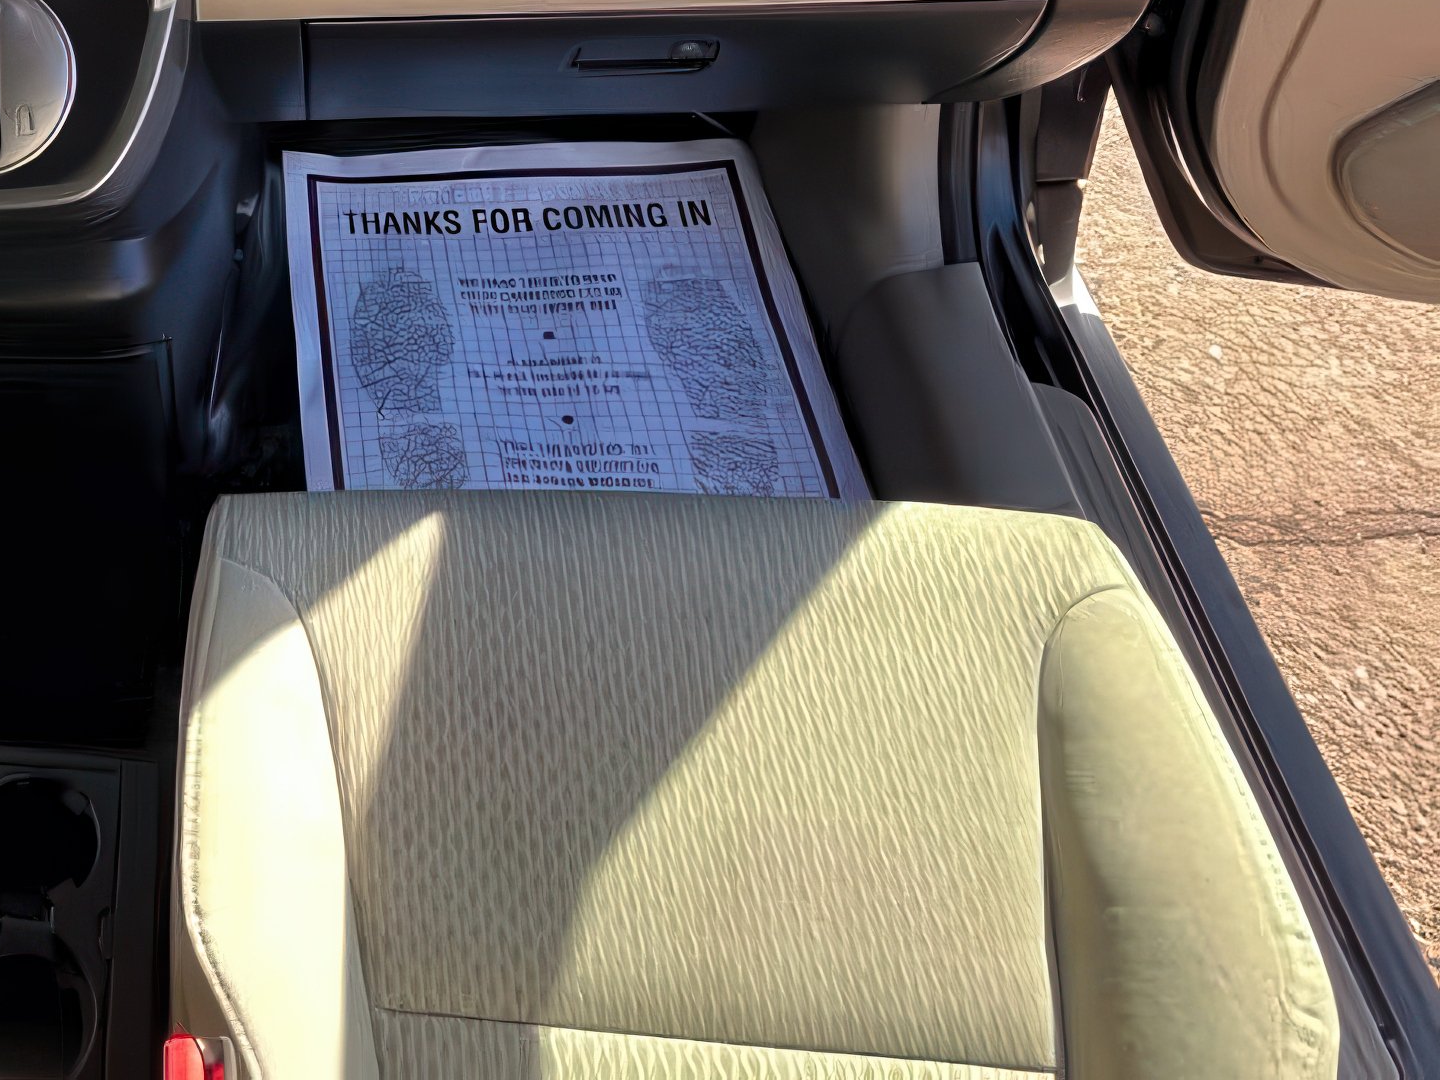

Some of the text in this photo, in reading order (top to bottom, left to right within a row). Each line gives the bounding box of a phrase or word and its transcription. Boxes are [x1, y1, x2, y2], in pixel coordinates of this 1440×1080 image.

[343, 200, 712, 235] THANKS FOR COMING IN
